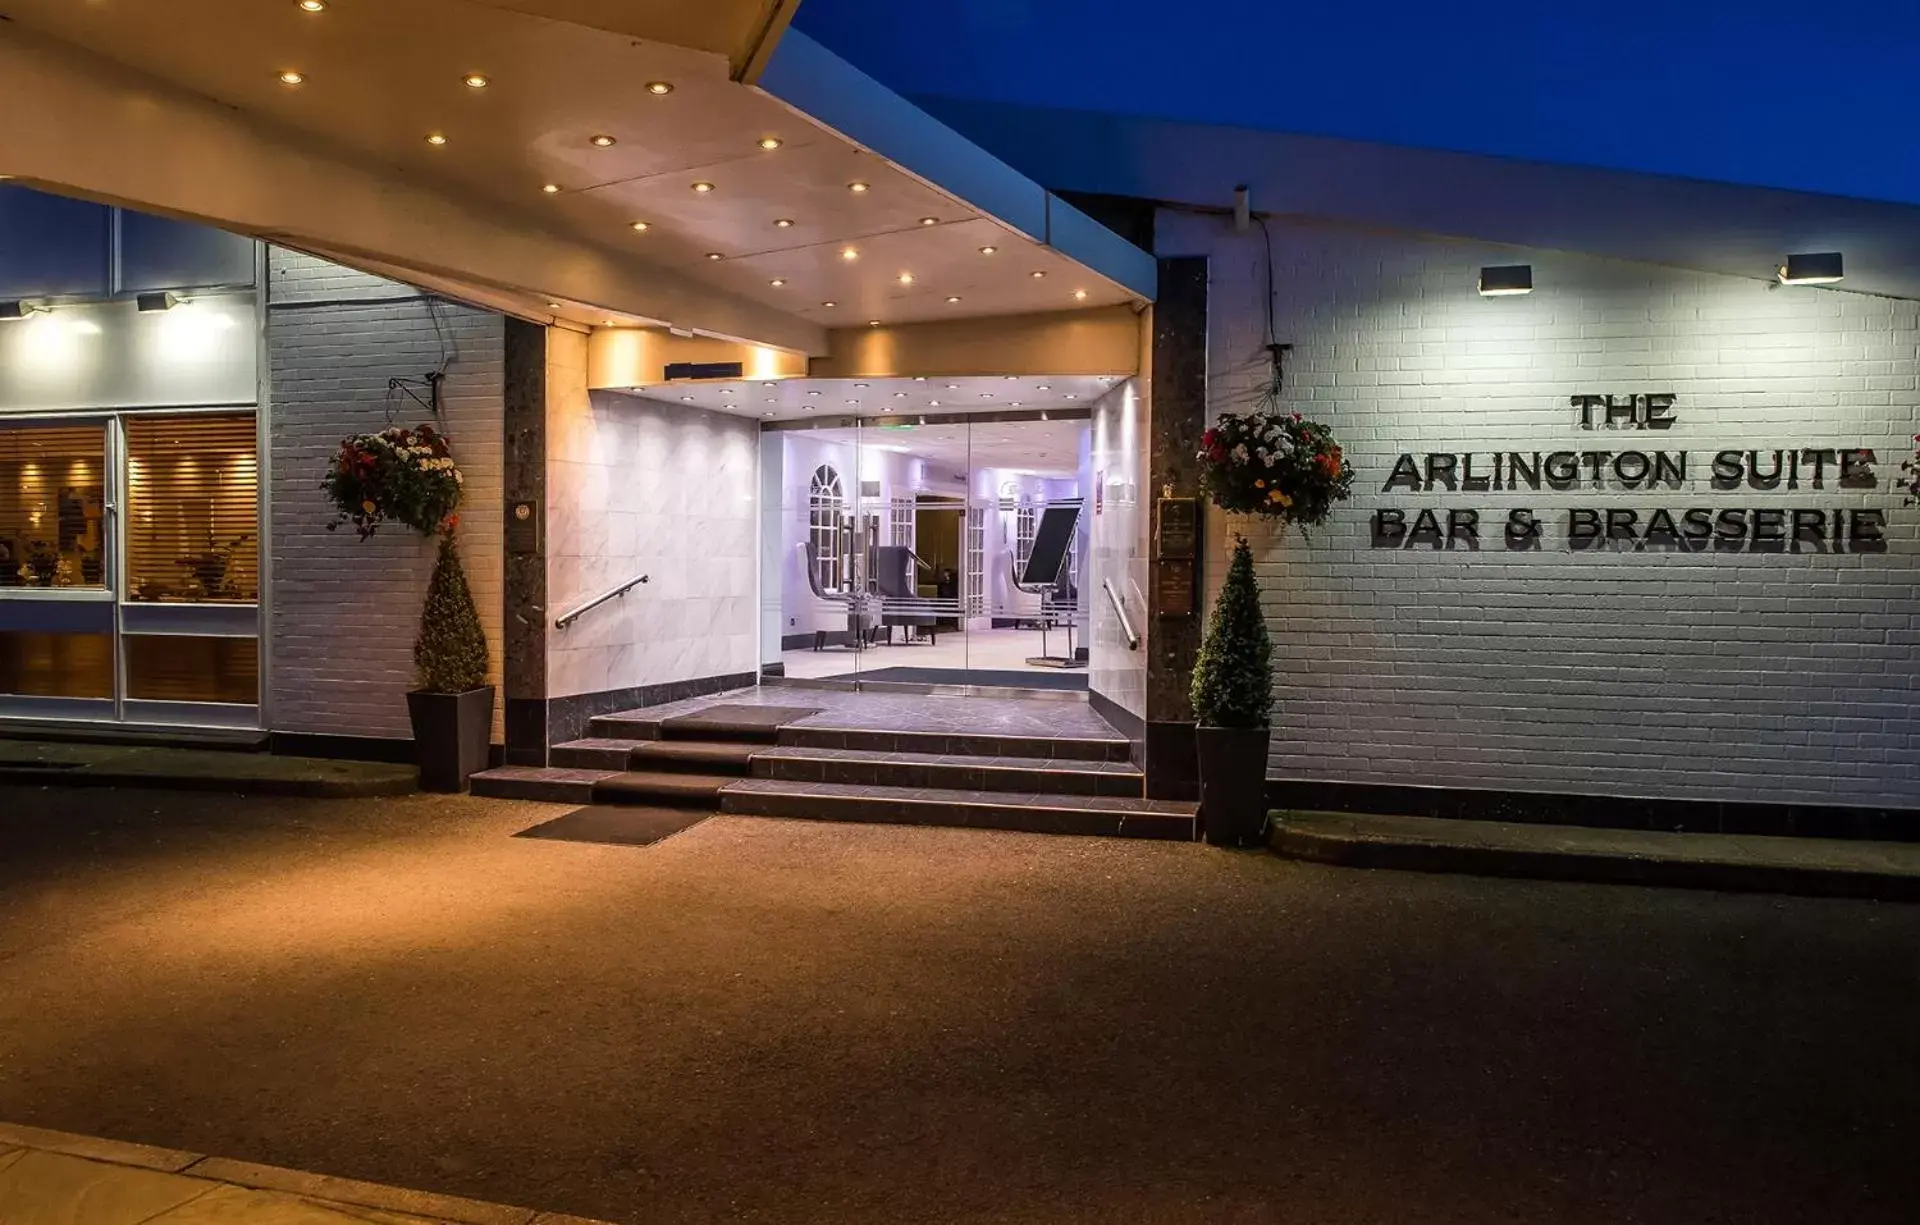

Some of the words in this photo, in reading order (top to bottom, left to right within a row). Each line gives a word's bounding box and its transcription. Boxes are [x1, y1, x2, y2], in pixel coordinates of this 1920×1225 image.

[1571, 394, 1677, 427] THE
[1383, 451, 1688, 486] ARLINGTON
[1712, 449, 1877, 486] SUITE
[1373, 509, 1480, 546] BAR
[1505, 509, 1542, 547] &
[1567, 509, 1887, 550] BRASSERIE
